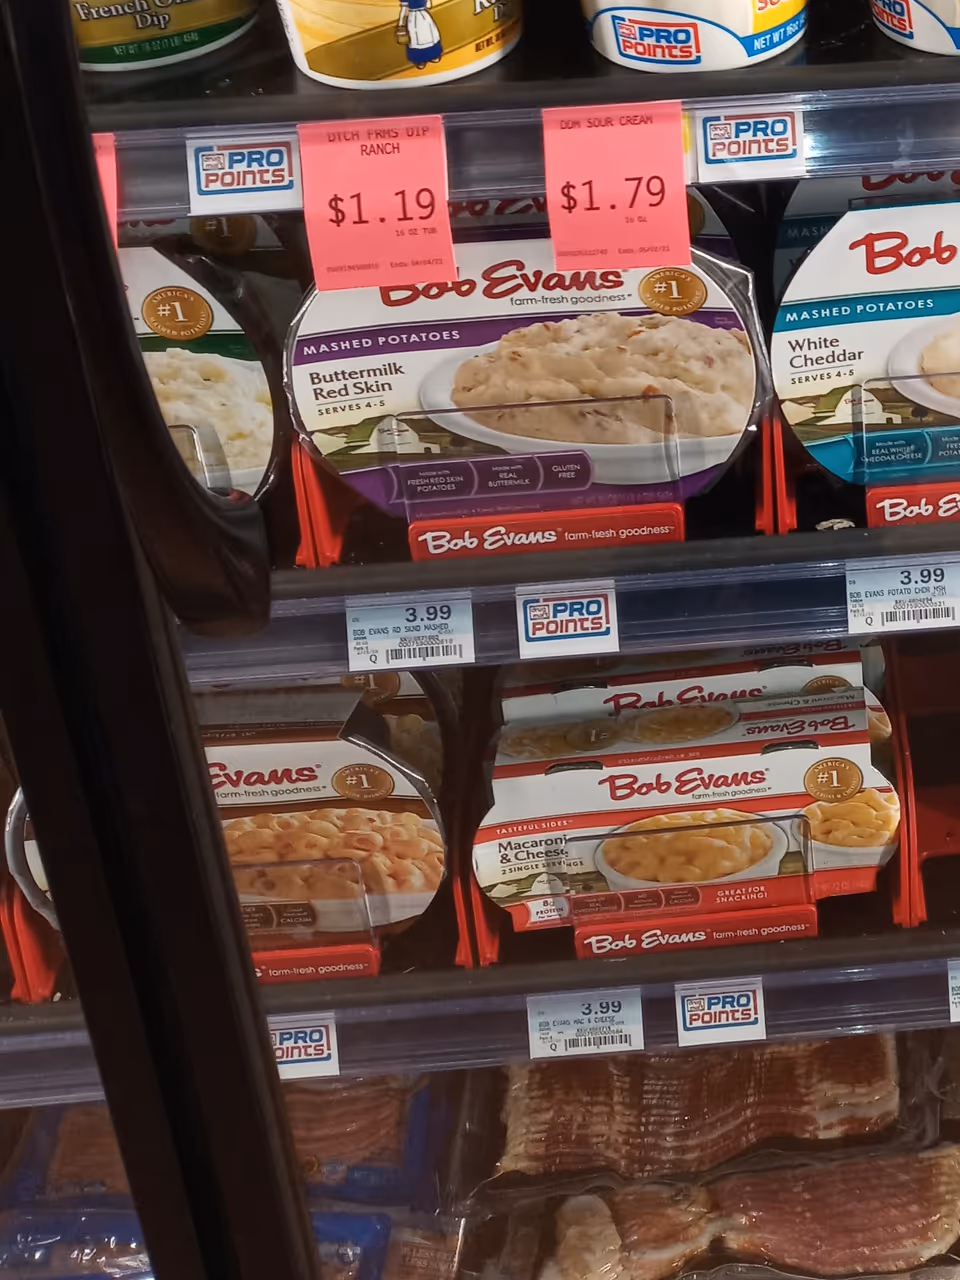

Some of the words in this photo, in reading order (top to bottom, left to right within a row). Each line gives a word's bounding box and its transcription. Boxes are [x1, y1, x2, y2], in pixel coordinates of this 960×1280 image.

[136, 10, 170, 30] Dip
[586, 117, 613, 129] SOUR
[618, 115, 654, 127] CREAM
[360, 143, 400, 156] RANCH
[560, 175, 666, 215] $1.79
[328, 187, 436, 227] $1.19
[849, 230, 957, 276] Bob
[483, 260, 626, 303] Evans
[785, 304, 851, 323] MASHED
[857, 297, 935, 314] POTATOES
[303, 336, 372, 356] MASHED
[378, 329, 461, 346] POTATOES
[788, 335, 840, 352] White
[789, 347, 864, 369] Cheddar
[308, 361, 405, 388] Buttermilk
[313, 383, 348, 401] Red
[352, 378, 393, 397] Skin
[318, 403, 360, 417] SERVES
[876, 496, 934, 522] Bob
[900, 567, 945, 585] 3.99
[865, 589, 884, 598] EVANS
[888, 588, 911, 596] POTATO
[405, 604, 452, 622] 3.99
[552, 599, 602, 618] PRO
[531, 616, 603, 636] POINTS
[598, 773, 672, 802] Bob
[676, 766, 766, 795] Evans
[496, 822, 536, 835] TASTEFUL
[539, 820, 567, 831] SIDES
[497, 833, 568, 855] Macaroni
[707, 992, 752, 1010] PRO
[688, 1007, 753, 1027] POINTS
